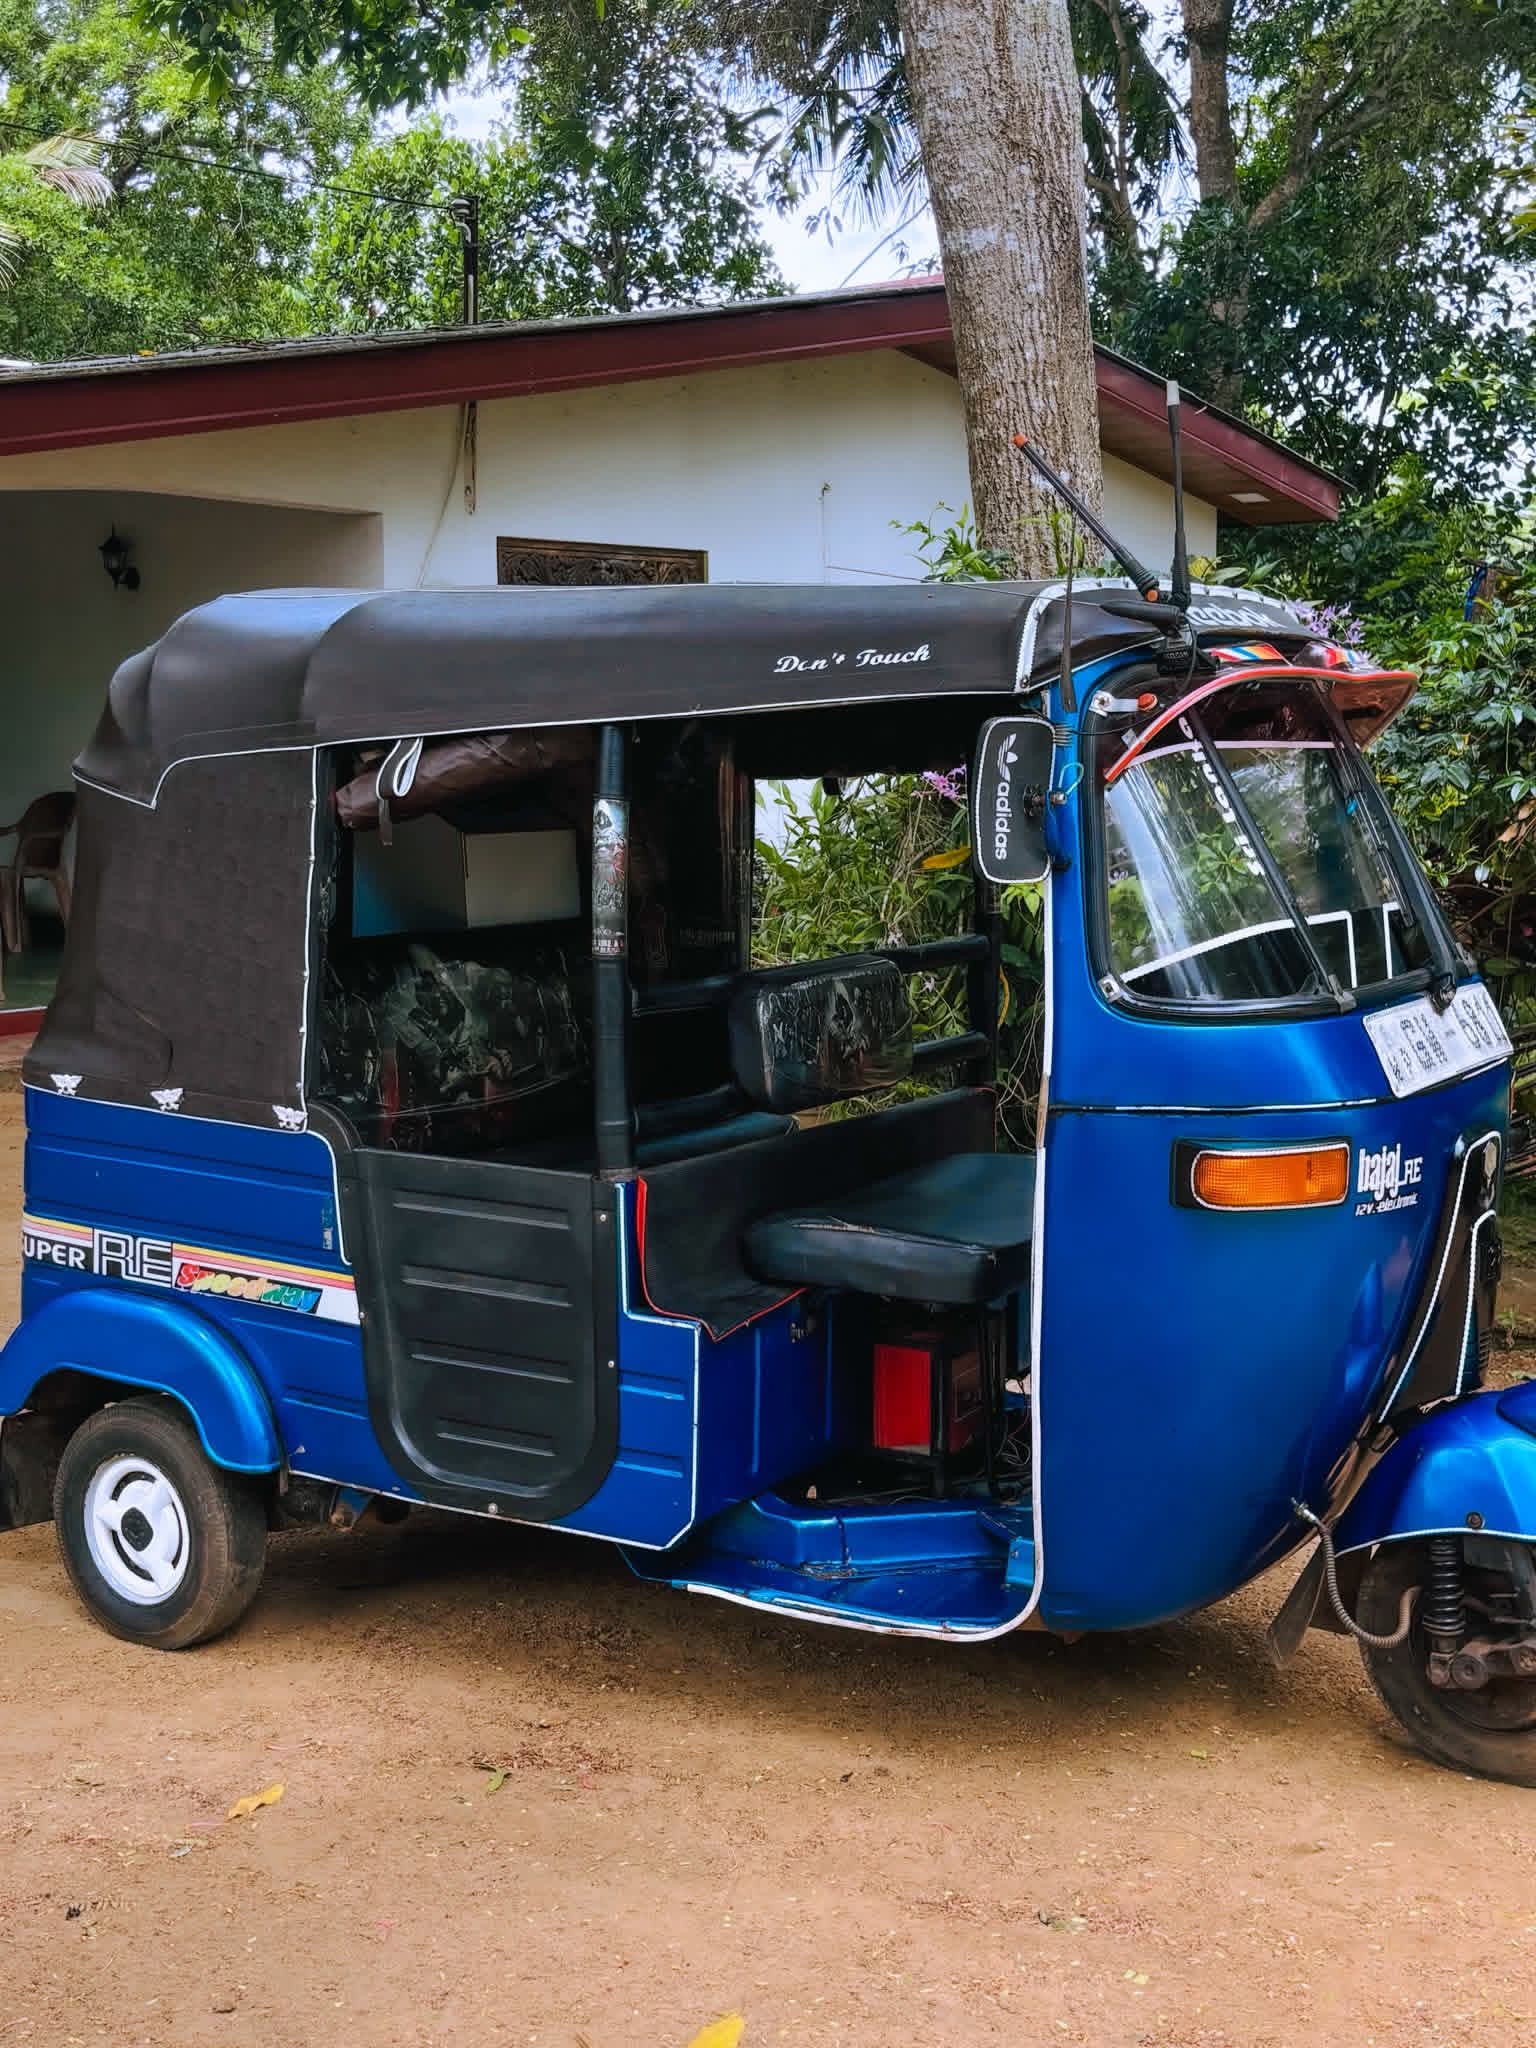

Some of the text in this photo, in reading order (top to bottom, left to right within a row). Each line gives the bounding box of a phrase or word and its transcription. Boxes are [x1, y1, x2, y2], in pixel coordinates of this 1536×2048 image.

[1186, 603, 1289, 629] eebok
[773, 643, 931, 673] Don't Touch
[994, 782, 1013, 861] adidas
[1357, 1143, 1401, 1201] bajaj
[23, 1235, 87, 1270] UPER
[93, 1228, 173, 1289] RE
